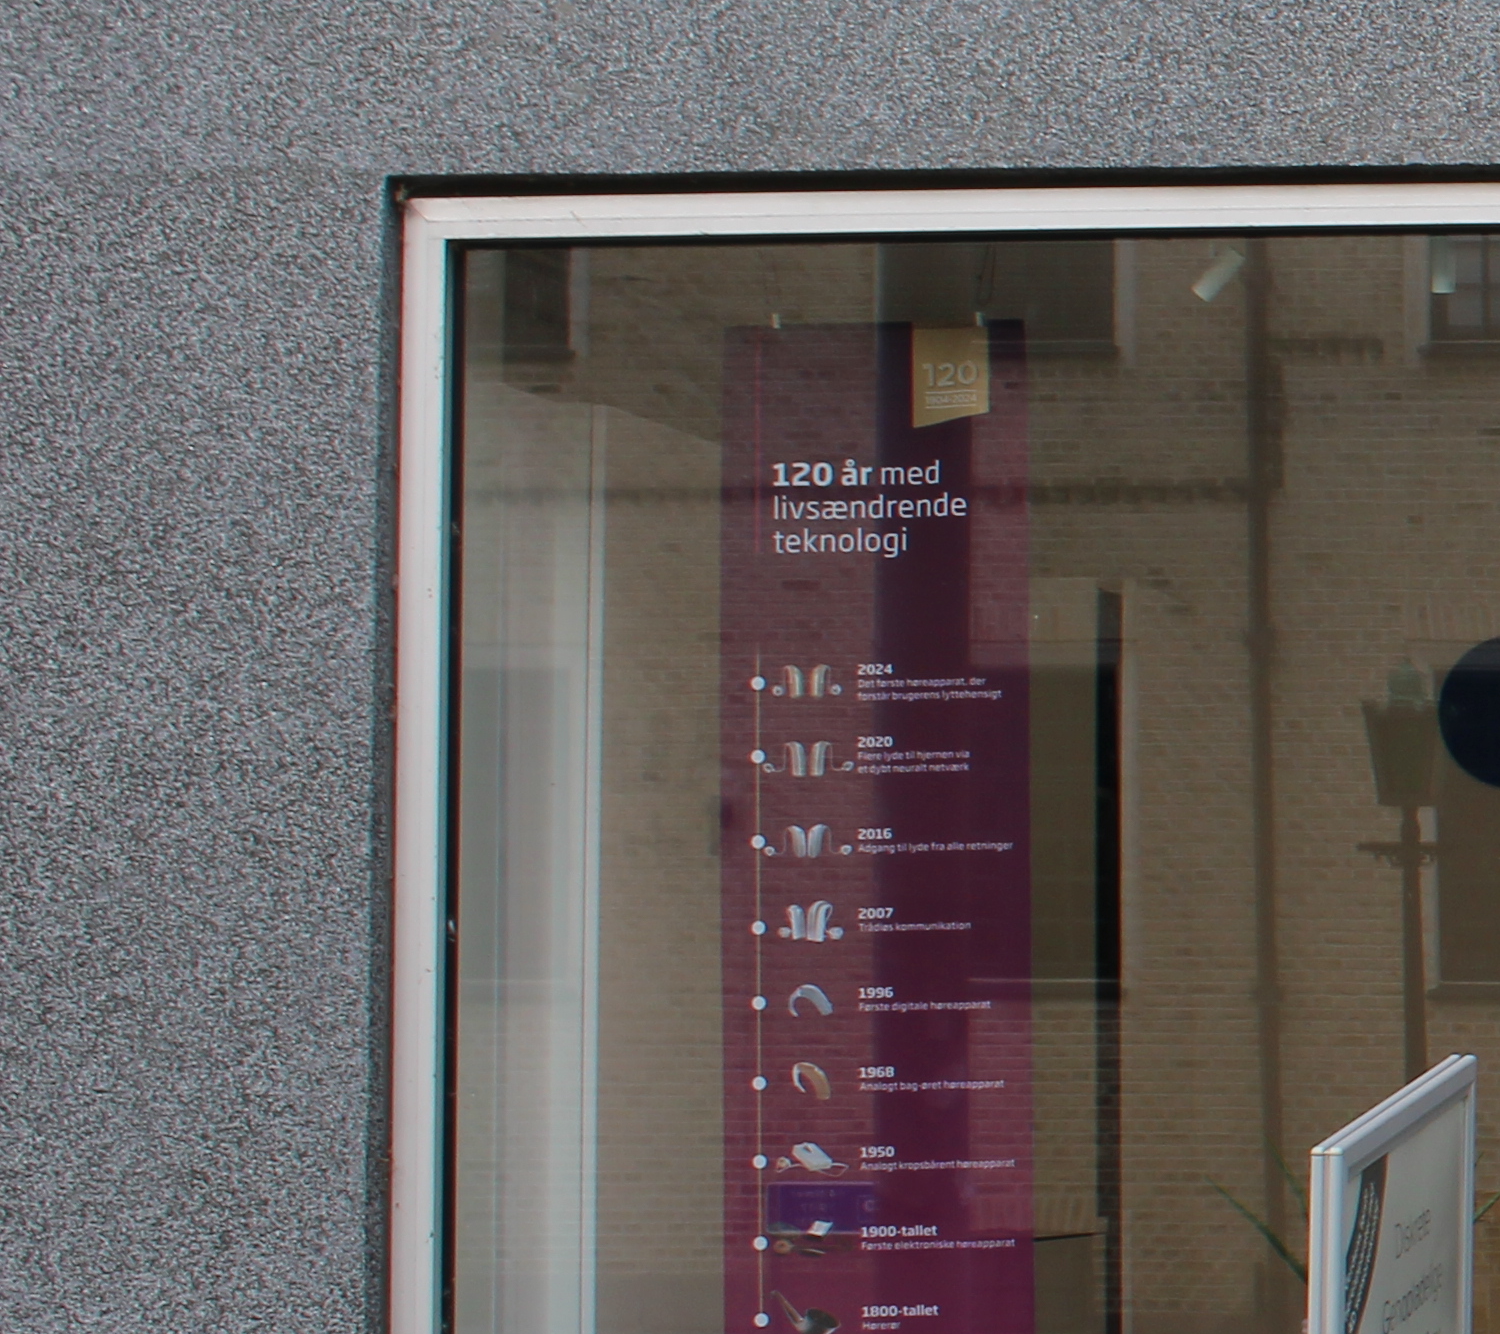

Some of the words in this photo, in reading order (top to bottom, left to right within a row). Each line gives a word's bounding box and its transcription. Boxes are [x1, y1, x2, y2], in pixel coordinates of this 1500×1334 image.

[922, 361, 978, 388] 120
[772, 463, 833, 486] 120
[841, 459, 872, 486] år
[880, 460, 940, 485] med
[773, 492, 967, 519] livsændrende
[774, 527, 907, 558] teknologi
[857, 664, 893, 675] 2024
[857, 736, 893, 748] 2020
[858, 828, 893, 840] 2016
[859, 844, 895, 854] Adgang
[897, 843, 908, 852] til
[909, 843, 930, 853] lyde
[931, 842, 945, 851] fra
[947, 842, 965, 851] alle
[966, 841, 1014, 852] retninger
[858, 908, 894, 919] 2007
[860, 923, 894, 932] Trådløs
[896, 922, 972, 931] kommunikation
[859, 987, 894, 999] 1996
[859, 1003, 890, 1011] Første
[892, 1002, 929, 1012] digitale
[931, 1000, 992, 1010] høreapparat
[860, 1066, 895, 1078] 1968
[860, 1082, 899, 1092] Analogt
[944, 1080, 1005, 1089] høreapparat
[861, 1146, 895, 1158] 1950
[861, 1162, 898, 1172] Analogt
[957, 1159, 1015, 1169] høreapparat
[861, 1225, 938, 1238] 1900-tallet
[861, 1242, 893, 1250] Første
[895, 1240, 954, 1249] elektroniske
[957, 1239, 1015, 1248] høreapparat
[862, 1305, 939, 1317] 1800-tallet
